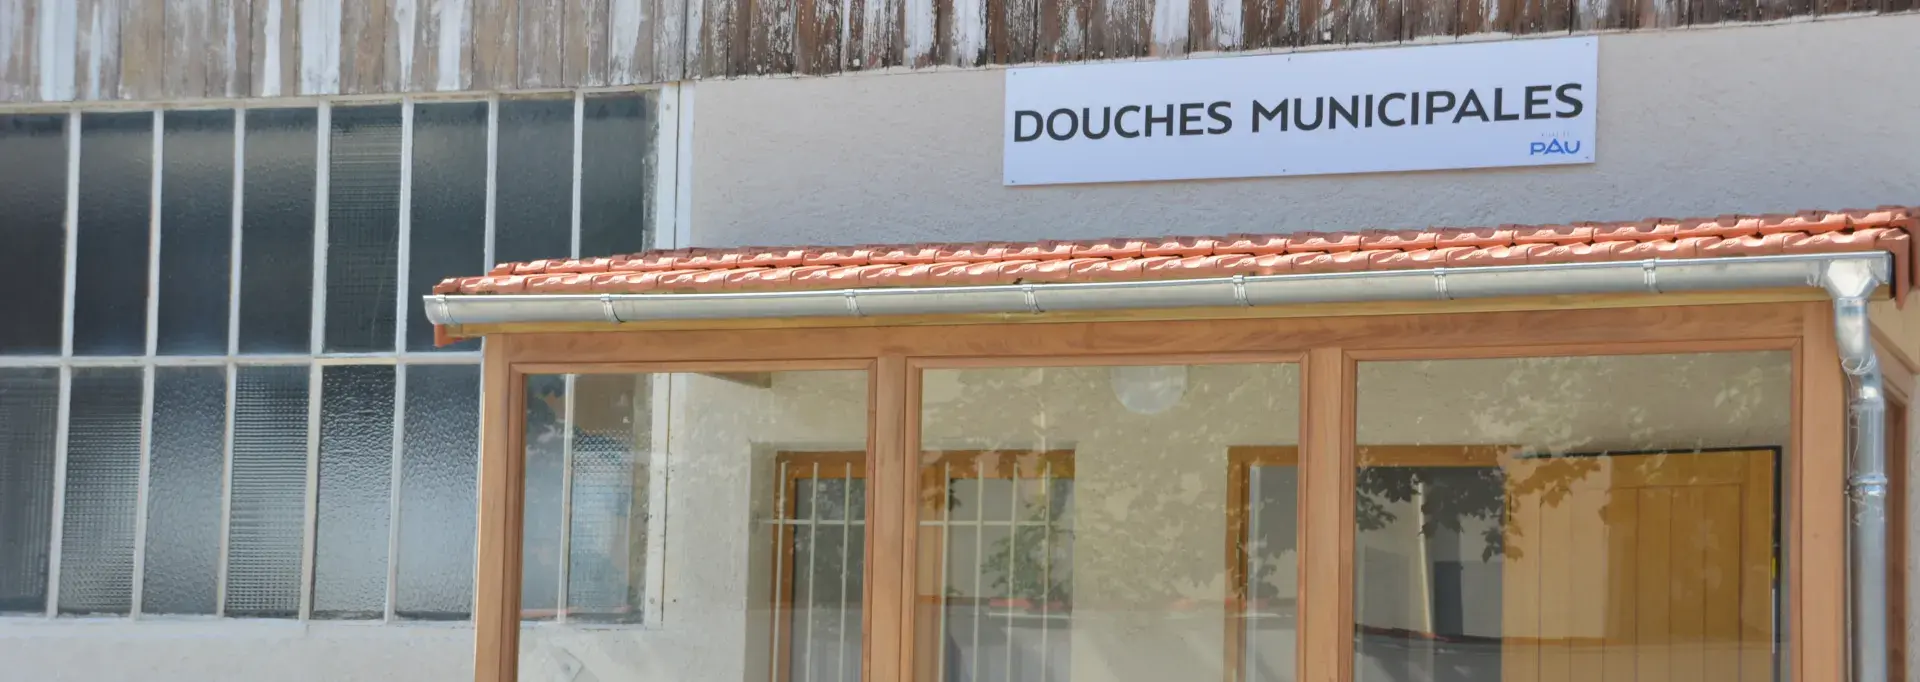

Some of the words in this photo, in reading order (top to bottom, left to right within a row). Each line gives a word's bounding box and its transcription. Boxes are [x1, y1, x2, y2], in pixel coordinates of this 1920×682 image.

[1013, 100, 1232, 142] DOUCHES
[1251, 82, 1584, 133] MUNICIPALES
[1530, 138, 1581, 155] PAU
